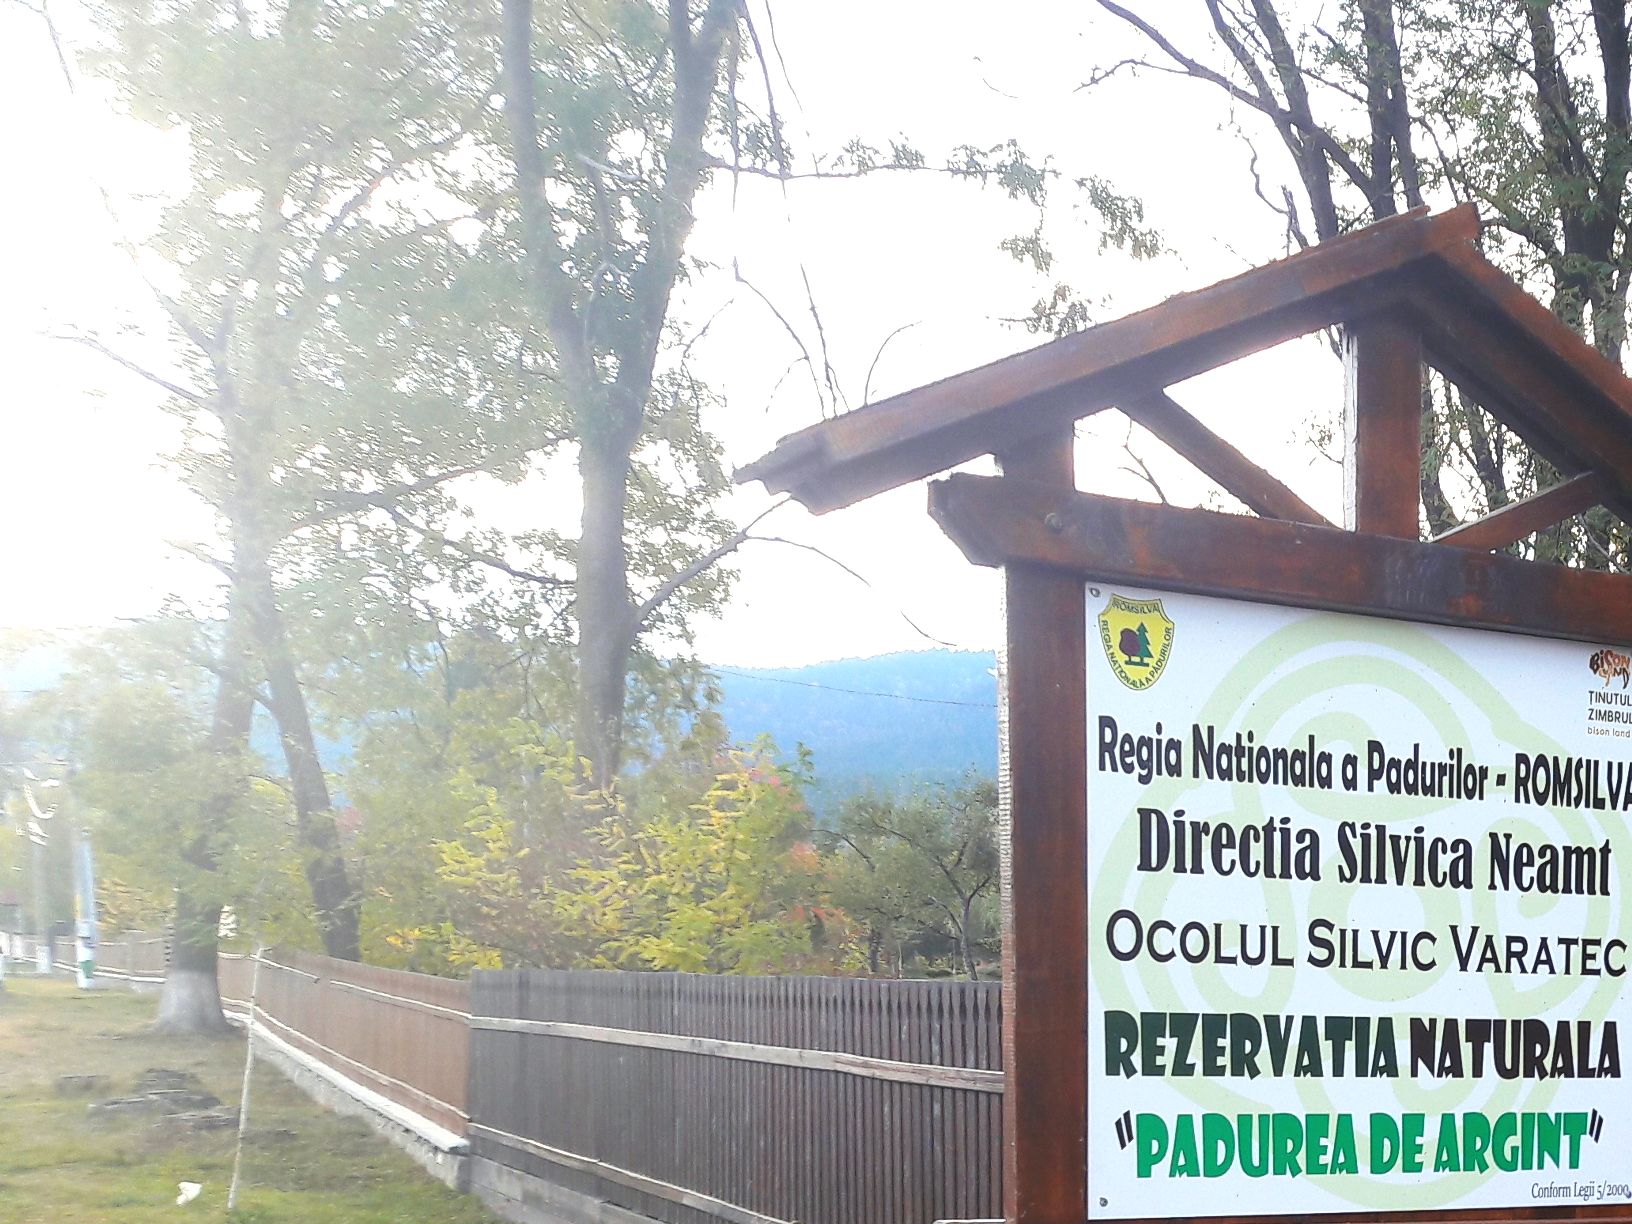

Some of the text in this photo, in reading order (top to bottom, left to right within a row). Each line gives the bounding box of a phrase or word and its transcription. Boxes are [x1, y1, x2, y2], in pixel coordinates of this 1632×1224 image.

[1112, 601, 1160, 614] ROMSILVA
[1101, 620, 1113, 651] REGIA
[1587, 726, 1631, 738] bison land
[1098, 715, 1182, 785] Regia
[1192, 723, 1333, 790] Nationala
[1341, 752, 1358, 792] a
[1367, 739, 1488, 801] Padurilor
[1136, 807, 1612, 896] Directia Silvica Neamt
[1103, 1010, 1622, 1082] REZERVATIA NATURALA
[1114, 1107, 1604, 1179] "PADUREA DE ARGINT"
[1531, 1181, 1571, 1198] Conform
[1573, 1181, 1595, 1201] Legii
